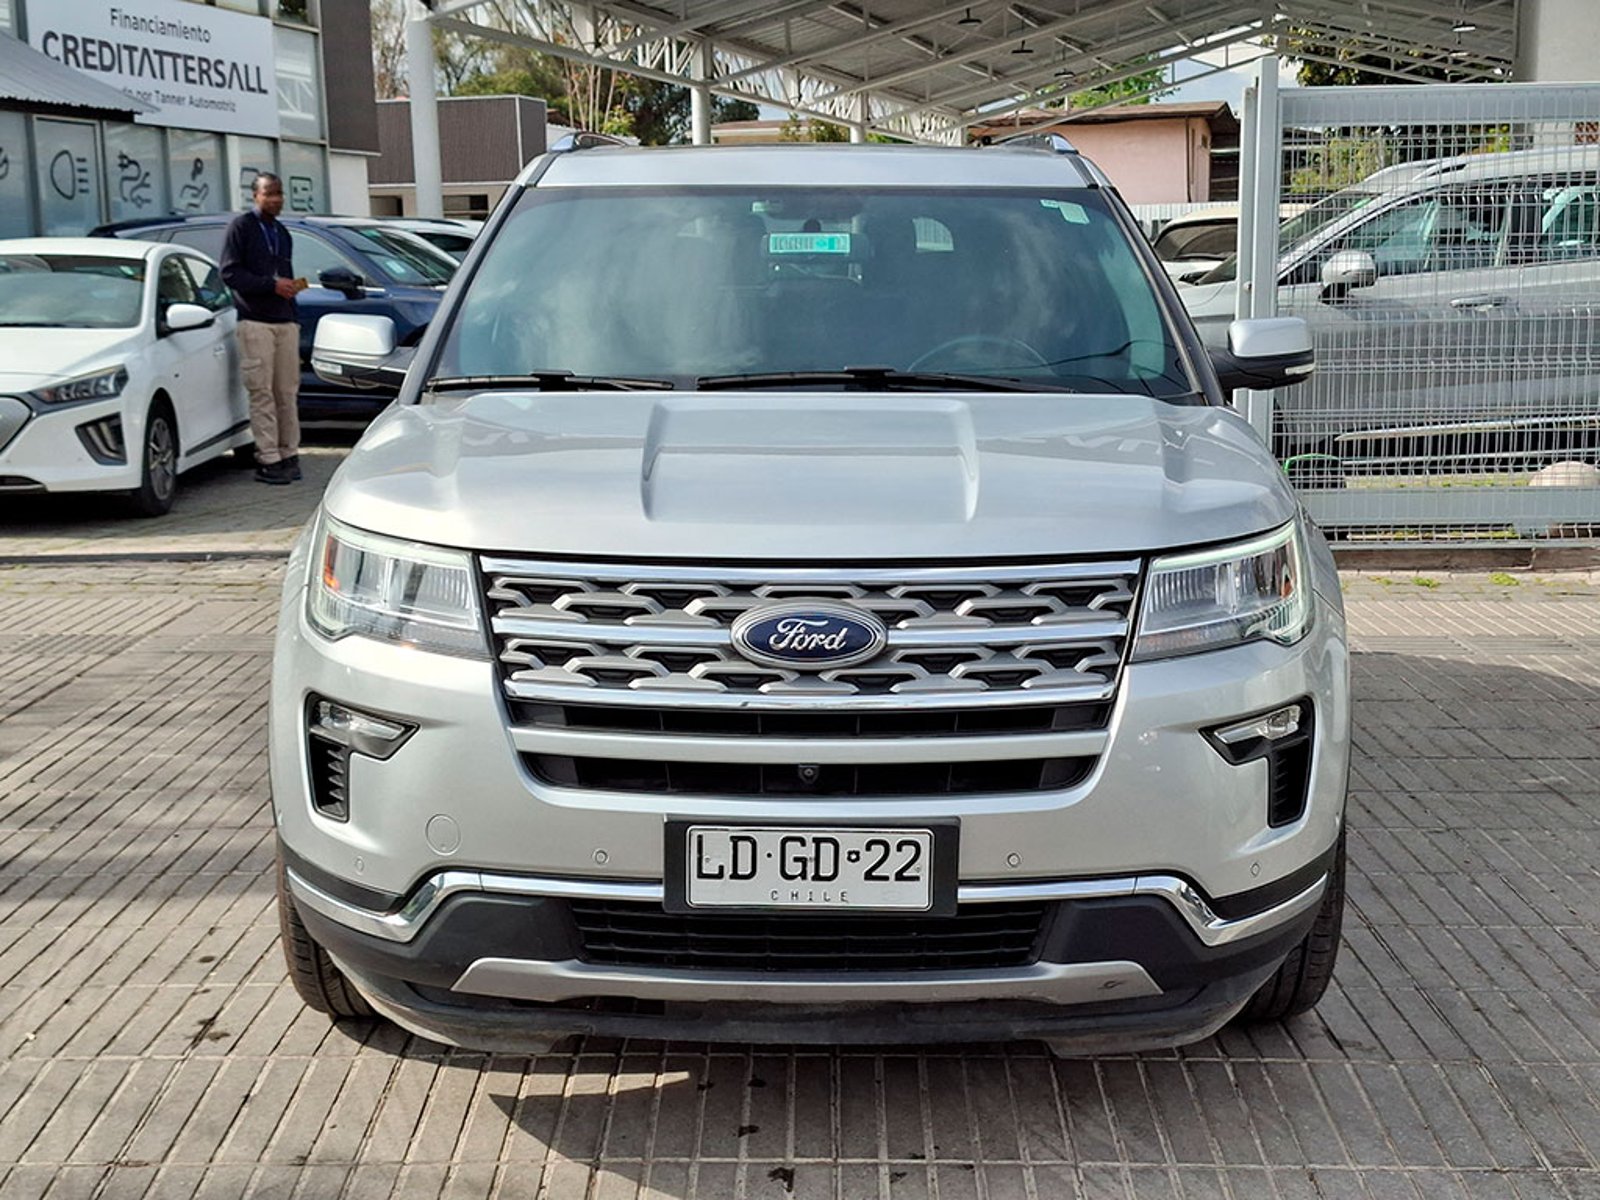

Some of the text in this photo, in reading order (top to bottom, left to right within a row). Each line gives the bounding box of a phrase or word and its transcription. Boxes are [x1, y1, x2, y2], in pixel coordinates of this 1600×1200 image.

[109, 8, 212, 43] Financiamiento
[42, 30, 269, 95] CREDITATTERSALL
[768, 618, 849, 650] Ford
[770, 890, 849, 903] CHILE
